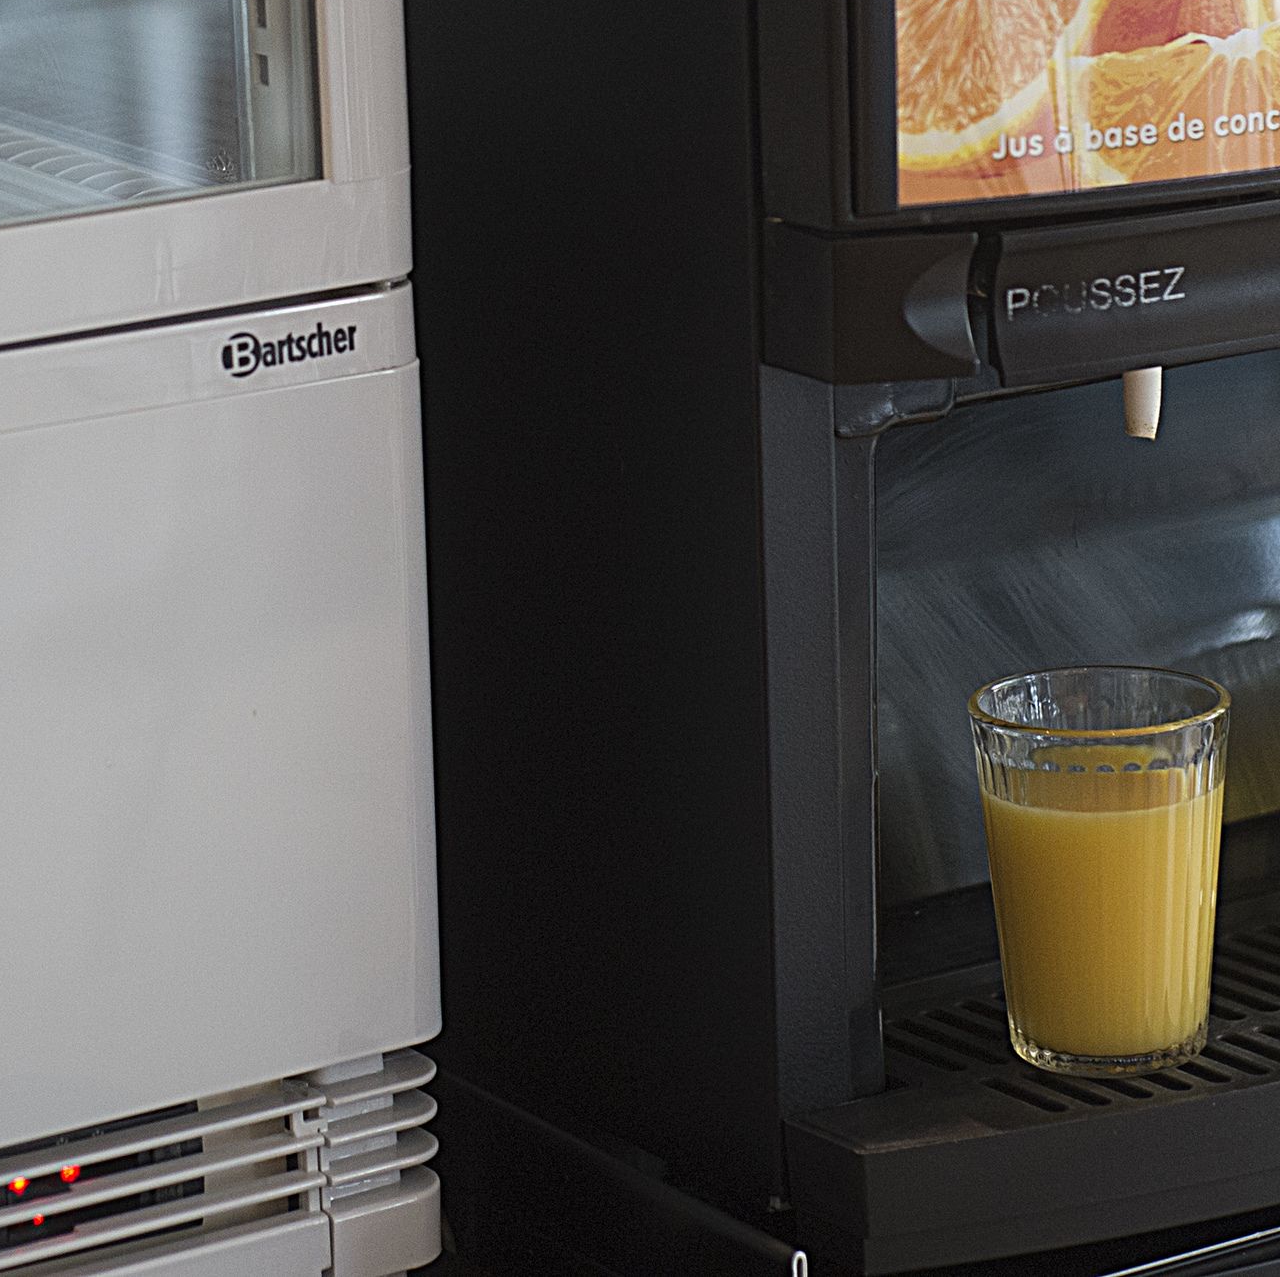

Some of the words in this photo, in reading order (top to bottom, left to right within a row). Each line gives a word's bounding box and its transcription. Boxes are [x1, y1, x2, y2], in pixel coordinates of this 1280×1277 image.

[992, 132, 1045, 160] Jus
[1054, 125, 1074, 154] à
[1085, 122, 1159, 151] base
[1167, 113, 1205, 143] de
[1006, 266, 1186, 321] POUSSEZ
[222, 322, 357, 378] Bartscher
